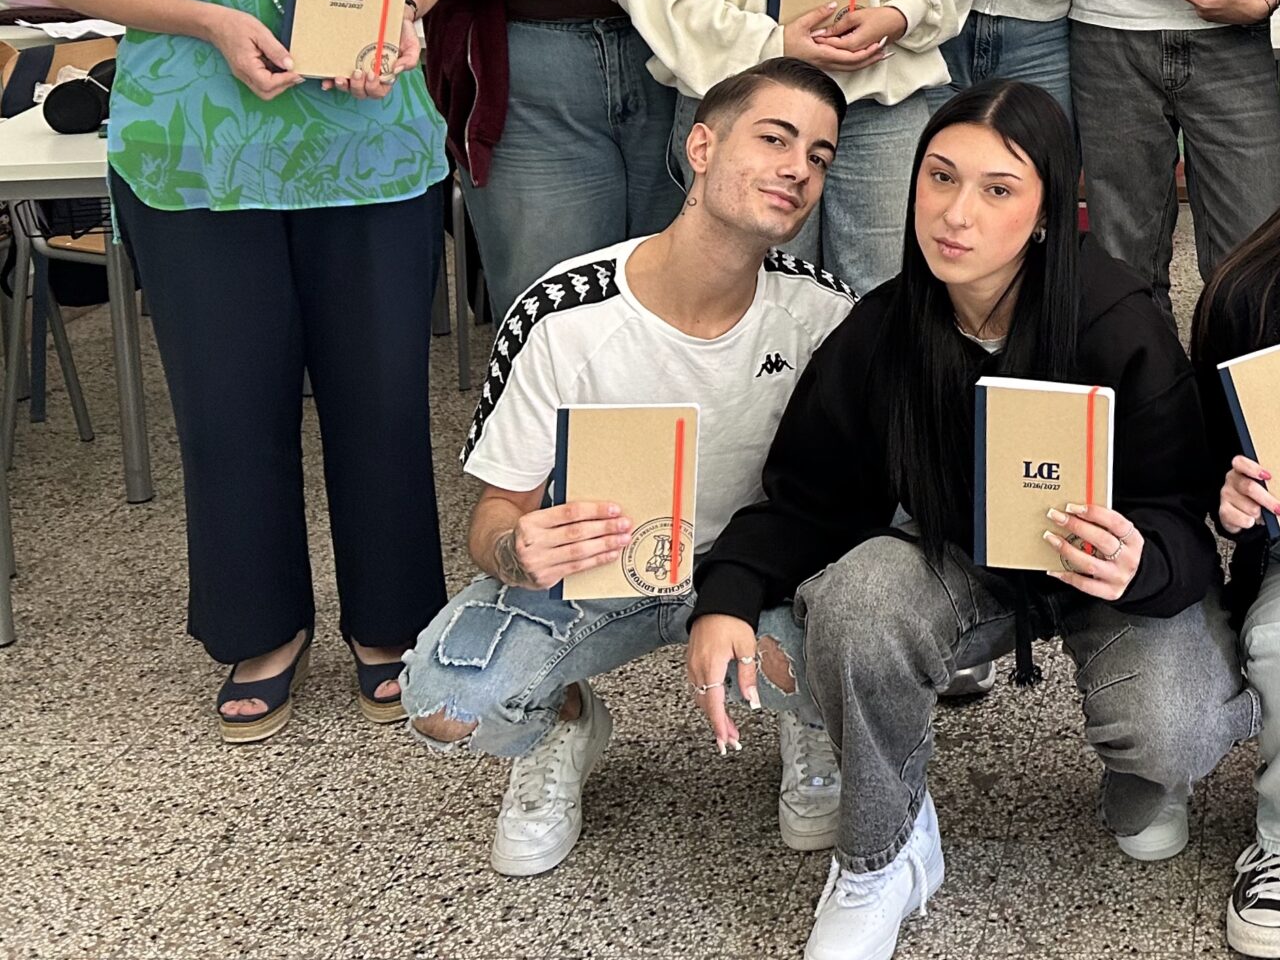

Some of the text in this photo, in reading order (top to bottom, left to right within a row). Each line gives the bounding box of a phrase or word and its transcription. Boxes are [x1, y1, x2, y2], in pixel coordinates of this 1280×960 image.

[1022, 481, 1061, 491] 2026/2027
[627, 566, 692, 594] ŒSCHER EDITORE
